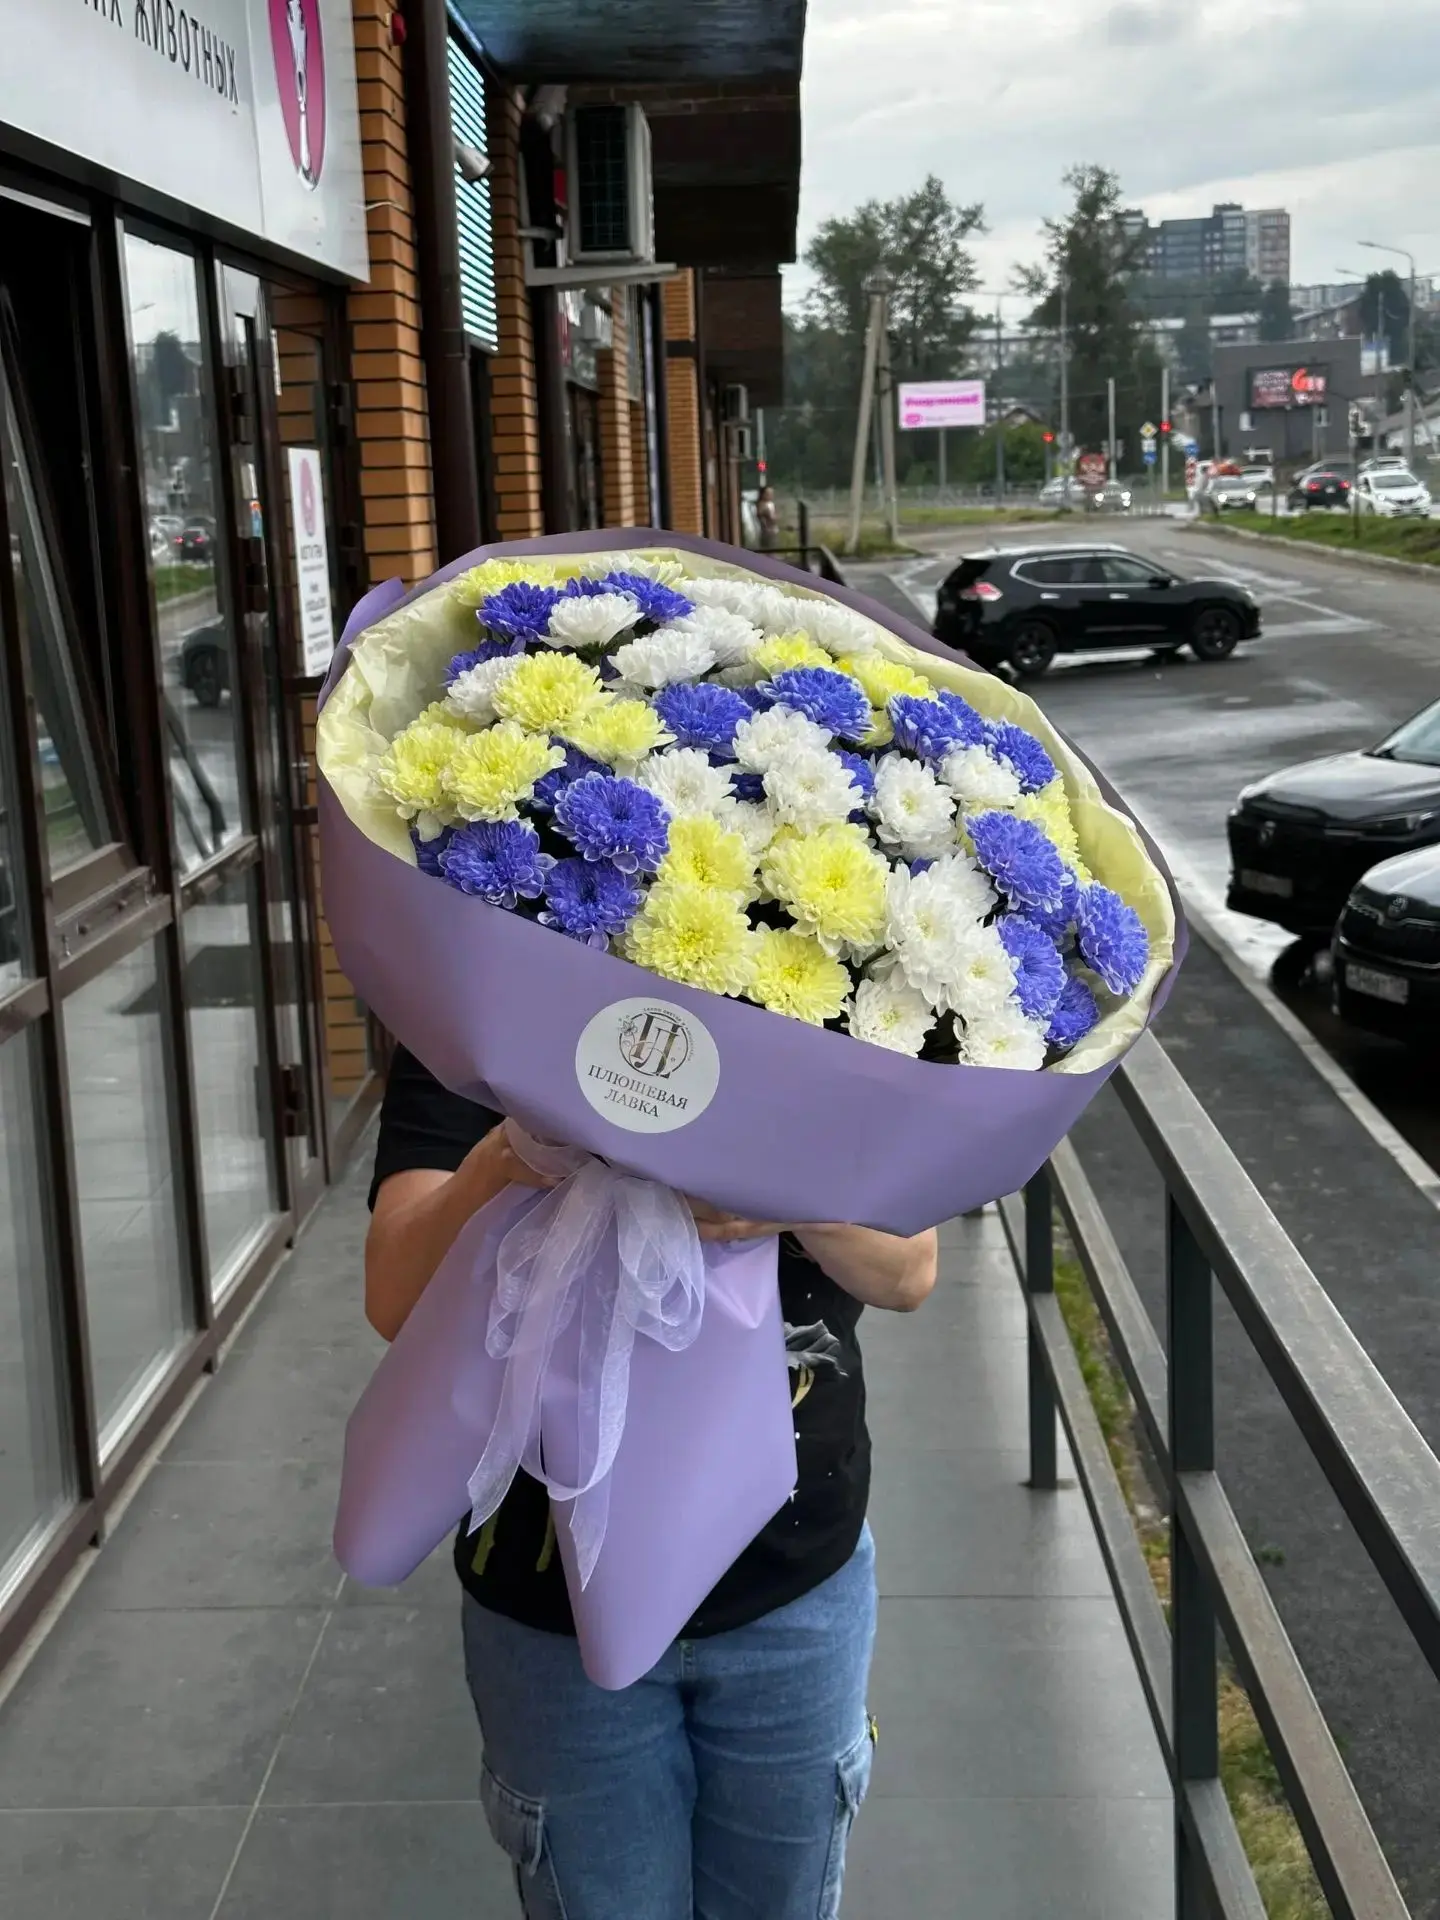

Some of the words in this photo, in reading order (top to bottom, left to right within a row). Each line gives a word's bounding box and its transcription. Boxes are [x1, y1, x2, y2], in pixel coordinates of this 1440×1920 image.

[134, 0, 239, 105] ЖИВОТНЫХ
[588, 1064, 689, 1110] ПЛЮШЕВАЯ
[604, 1088, 659, 1118] ЛАВКА
